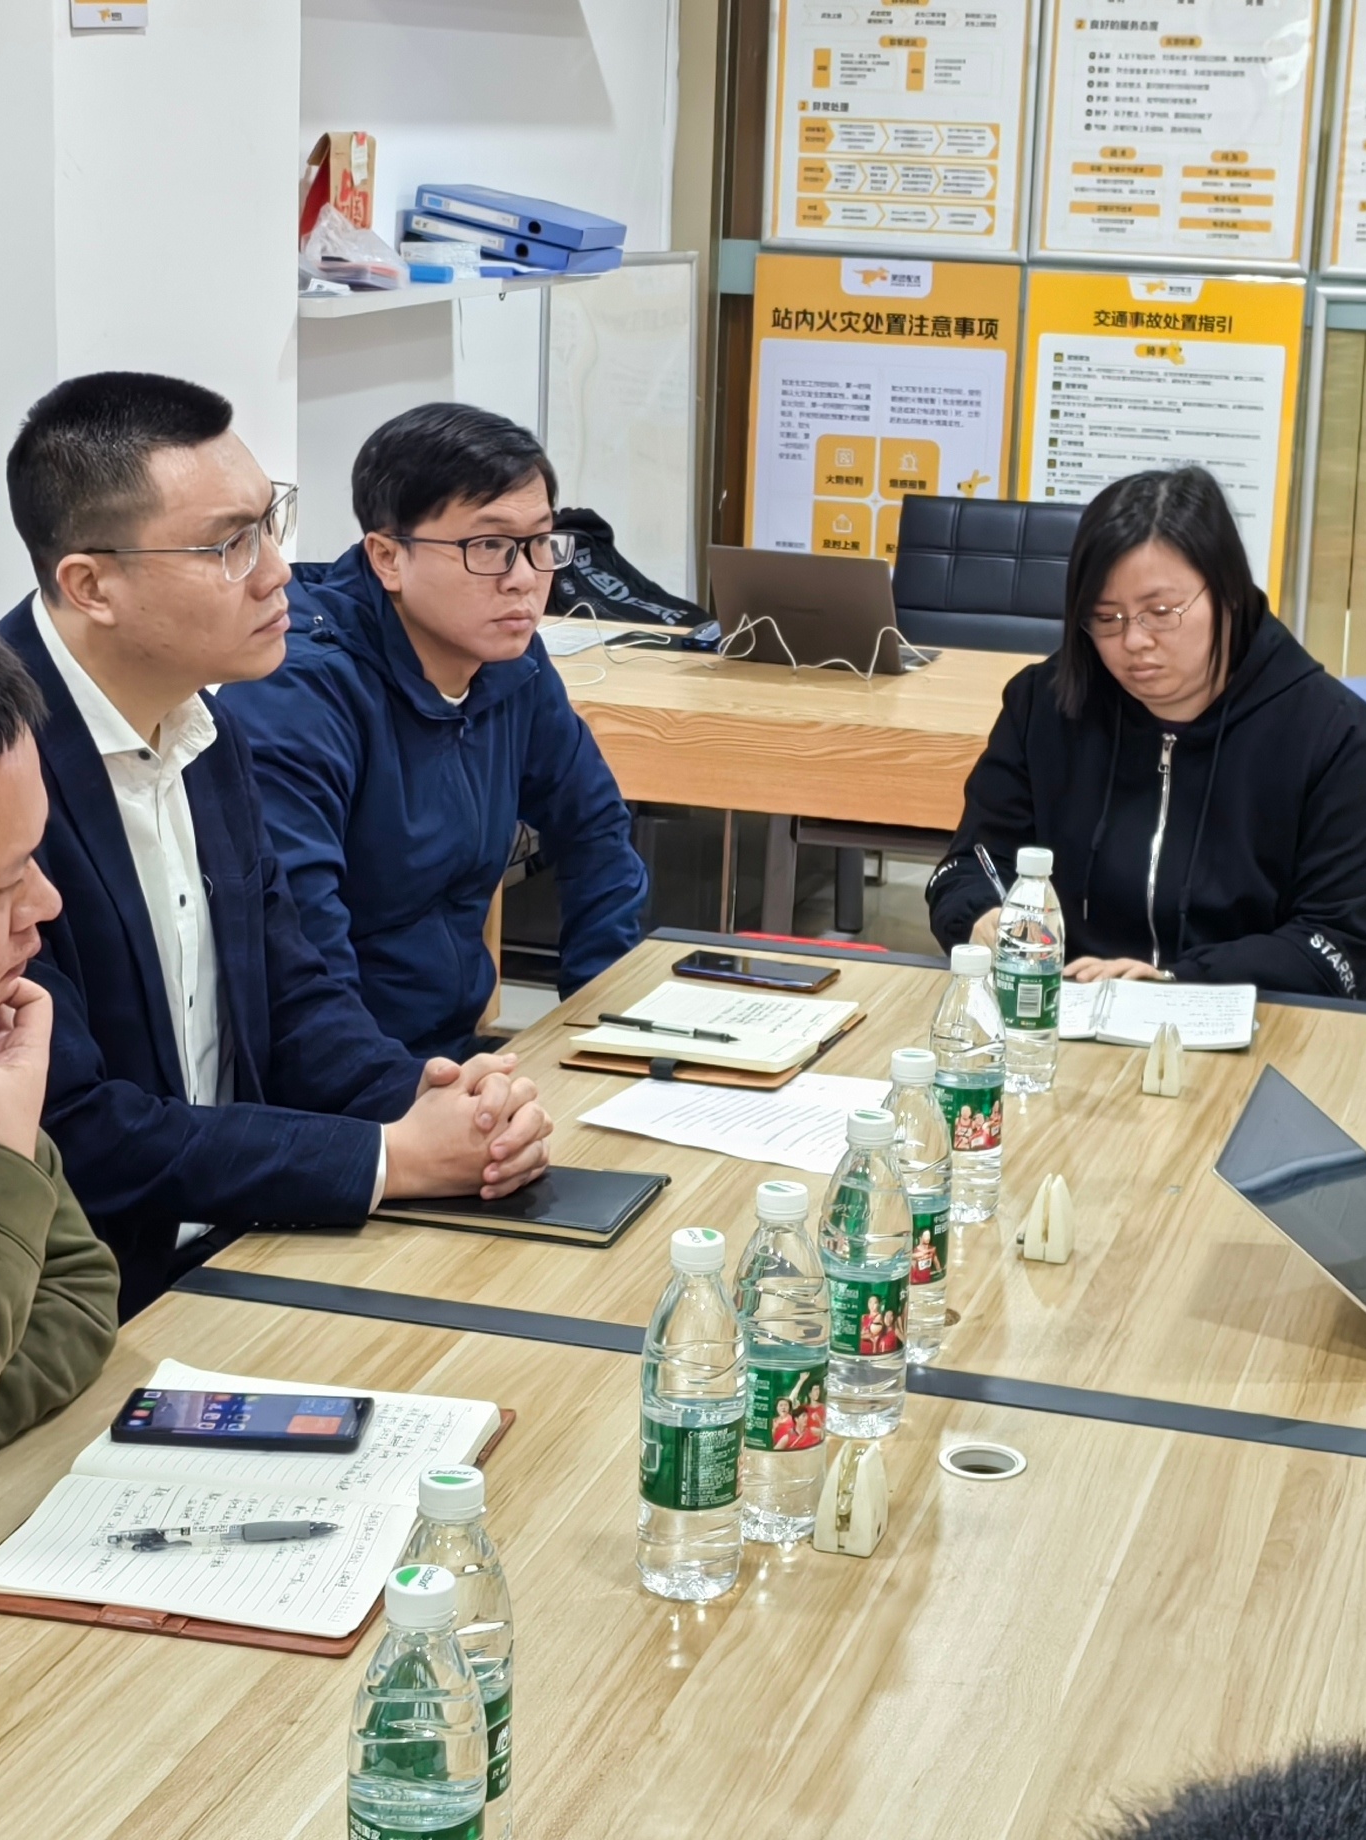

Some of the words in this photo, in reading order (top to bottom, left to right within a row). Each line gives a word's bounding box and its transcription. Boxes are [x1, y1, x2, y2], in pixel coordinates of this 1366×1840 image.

[1090, 20, 1159, 31] 良好的服务态度
[771, 307, 999, 340] 站内火灾处置注意事项
[1093, 310, 1233, 334] 交通事故处置指引
[1310, 933, 1356, 992] STARRY
